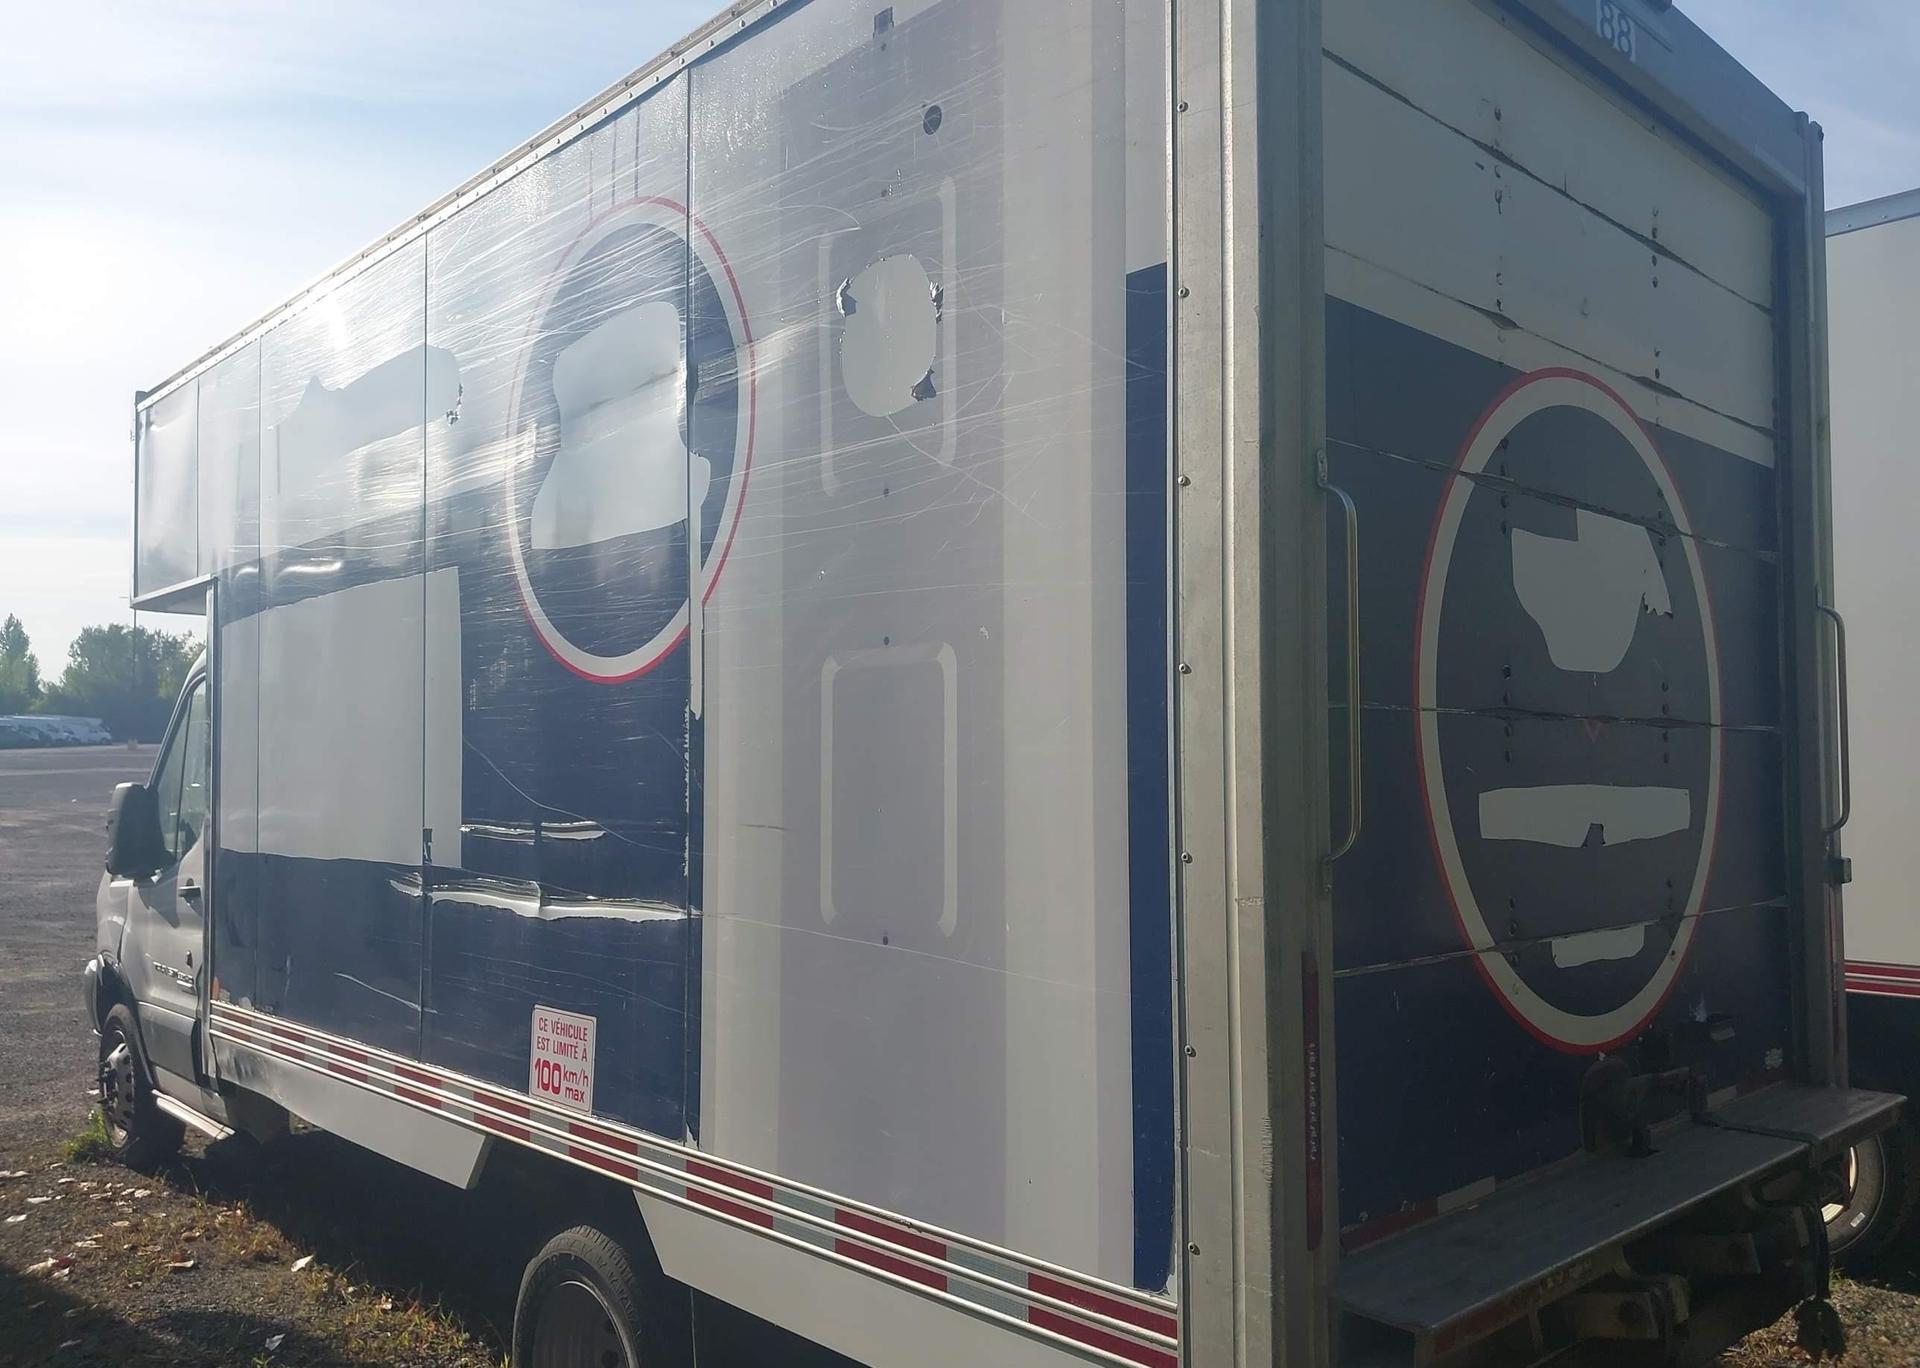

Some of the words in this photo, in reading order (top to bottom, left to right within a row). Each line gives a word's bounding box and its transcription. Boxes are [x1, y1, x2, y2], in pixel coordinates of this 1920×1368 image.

[538, 1017, 548, 1033] CE
[551, 1018, 588, 1042] VÉHICULE
[537, 1036, 550, 1052] EST
[553, 1040, 578, 1060] LIMITÉ
[581, 1043, 588, 1062] À
[534, 1058, 562, 1095] 100
[563, 1065, 589, 1087] km/h
[565, 1086, 585, 1103] max
